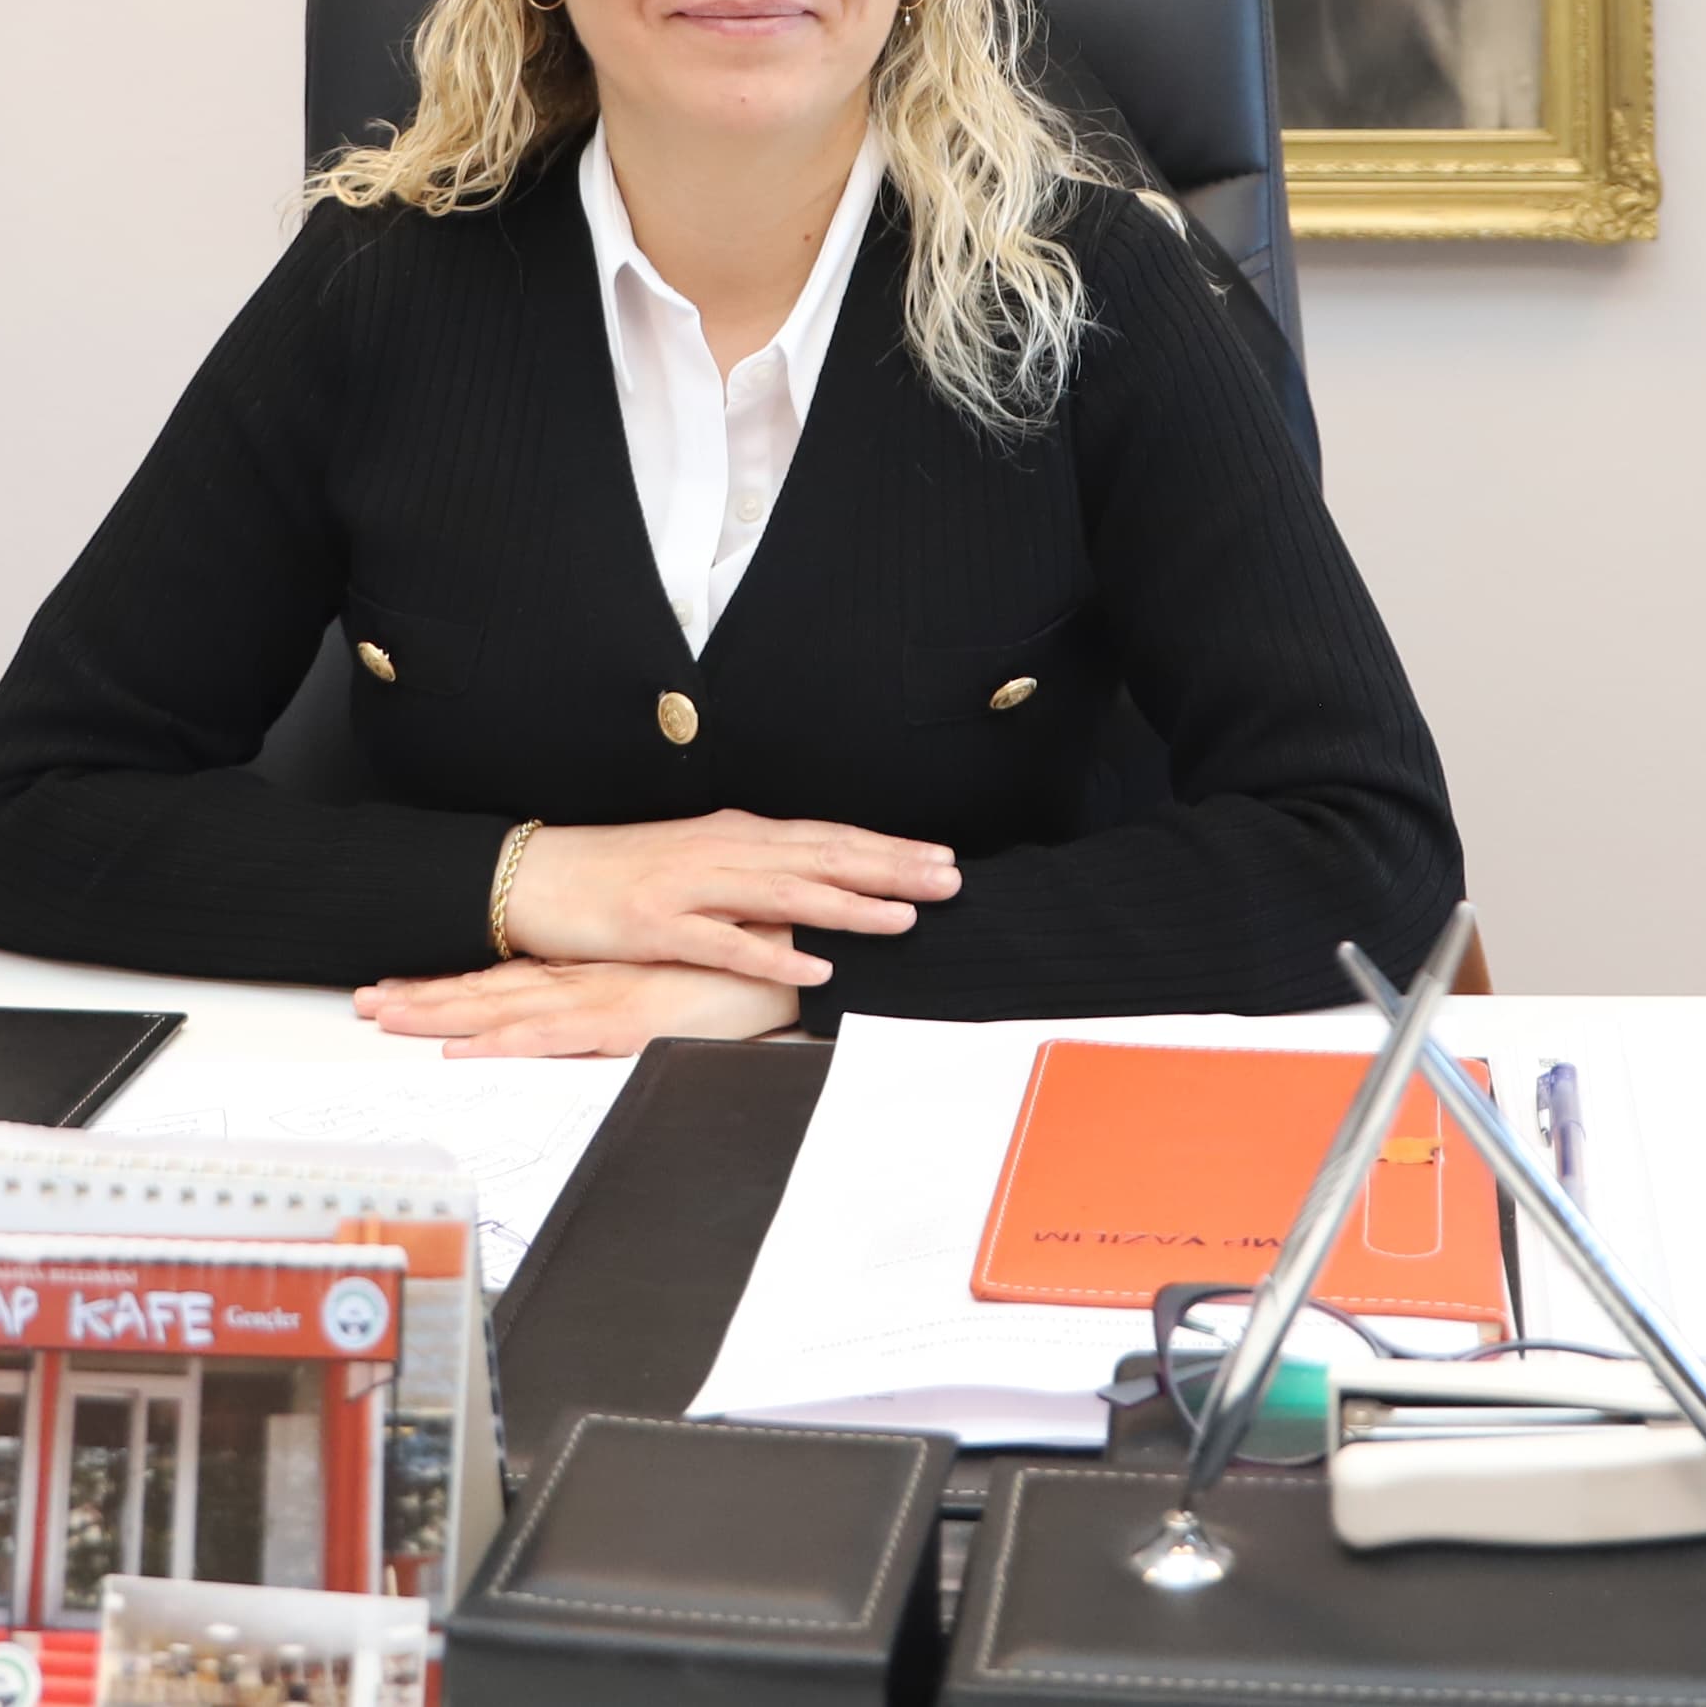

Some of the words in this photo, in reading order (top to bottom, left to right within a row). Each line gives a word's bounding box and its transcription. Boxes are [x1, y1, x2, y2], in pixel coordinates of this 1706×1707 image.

[1033, 1231, 1207, 1247] YAZILIM
[69, 1289, 216, 1345] KAFE
[223, 1304, 302, 1331] Gençler
